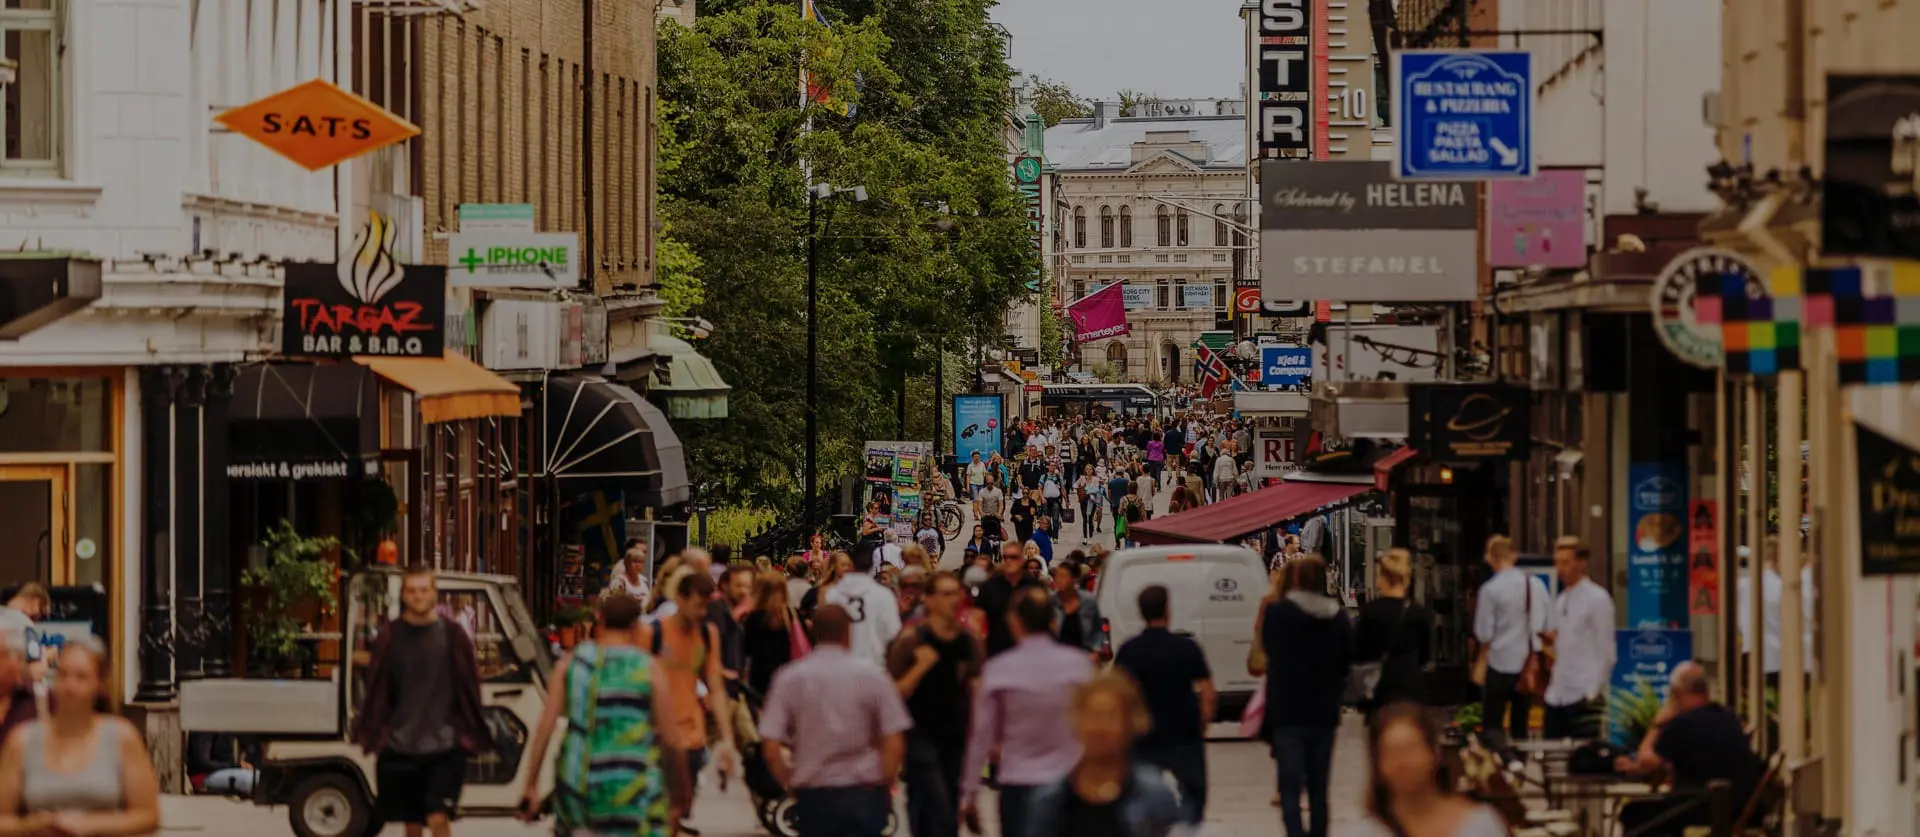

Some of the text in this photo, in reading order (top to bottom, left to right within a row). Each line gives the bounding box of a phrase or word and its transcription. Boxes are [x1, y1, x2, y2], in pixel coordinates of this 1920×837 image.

[1341, 88, 1367, 119] 10
[1436, 121, 1480, 135] PIZZA
[1428, 148, 1489, 163] SALLAD
[1273, 183, 1465, 212] Selected by HELENA
[488, 247, 568, 263] IPHONE
[1294, 256, 1445, 274] STEFANEL
[291, 297, 434, 336] TARGAZ
[1077, 323, 1125, 342] smarteyes
[303, 334, 423, 354] BAR & B.B.Q
[1277, 355, 1306, 366] Kjell &
[1269, 366, 1312, 377] Company
[278, 460, 290, 478] &
[292, 458, 348, 480] grekiskt
[848, 597, 865, 622] 3
